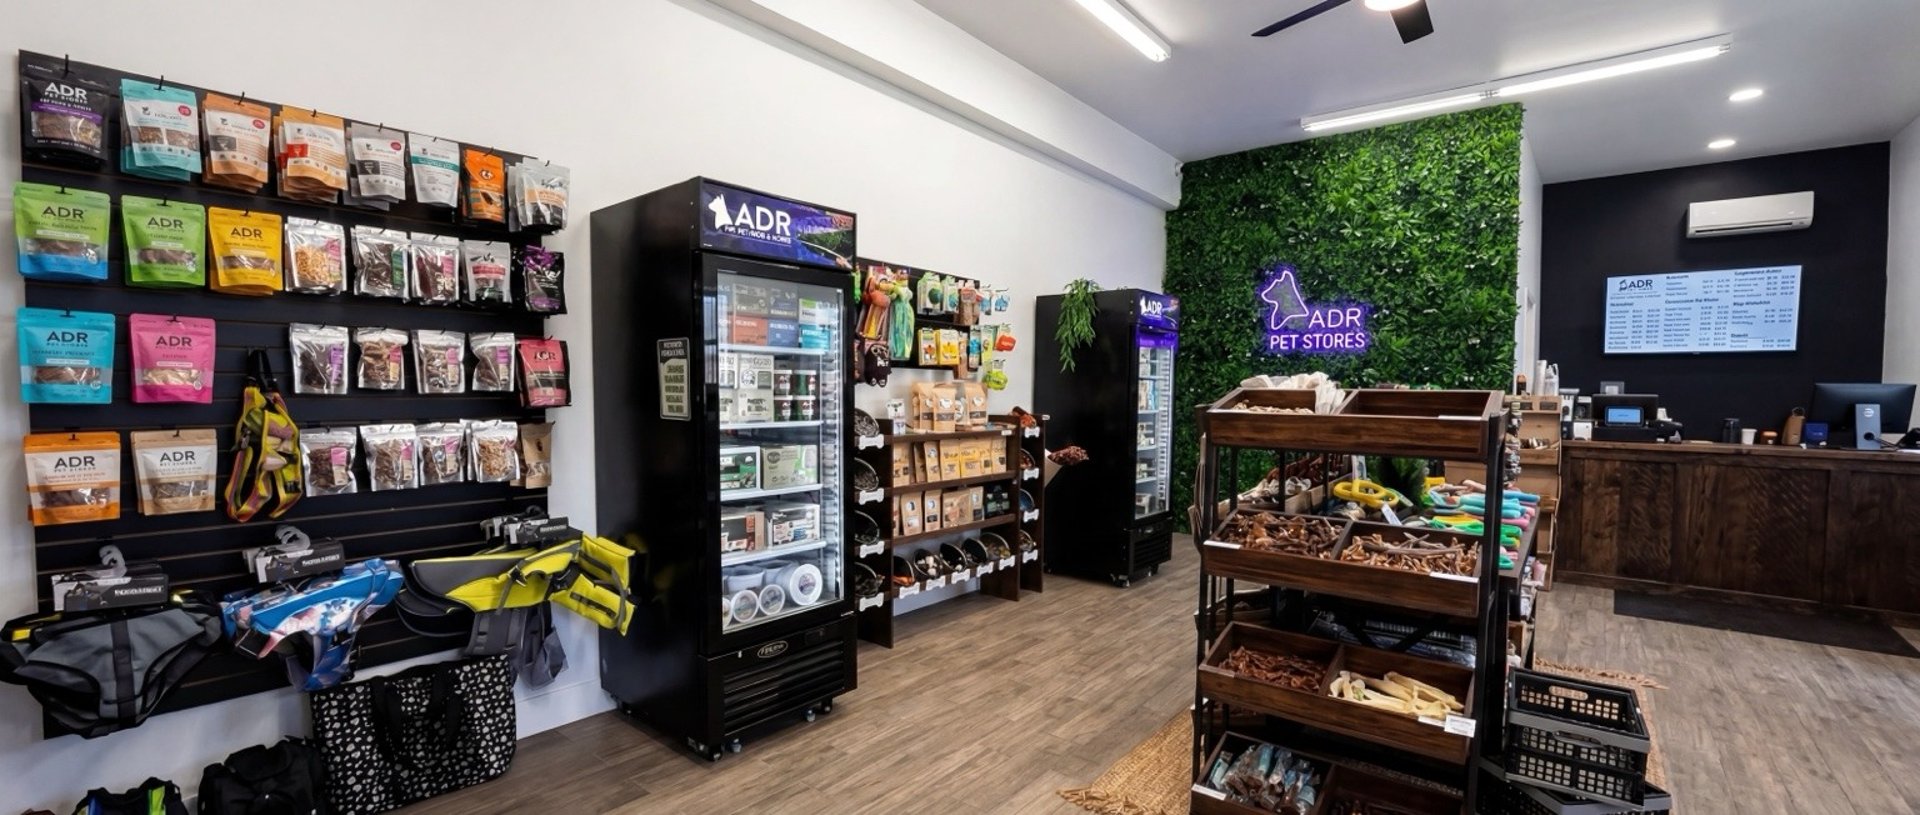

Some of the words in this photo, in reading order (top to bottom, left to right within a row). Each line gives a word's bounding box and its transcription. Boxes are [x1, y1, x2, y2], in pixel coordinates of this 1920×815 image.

[45, 82, 88, 101] ADR
[42, 206, 84, 219] ADR
[734, 202, 791, 236] ADR
[147, 216, 184, 229] ADR
[230, 227, 263, 239] ADR
[1628, 279, 1653, 289] ADR
[1147, 300, 1163, 316] ADR
[1308, 308, 1361, 329] ADR
[47, 331, 89, 343] ADR
[156, 335, 192, 347] ADR
[1270, 334, 1299, 350] PET
[1303, 333, 1365, 349] STORES
[54, 456, 95, 469] ADR
[160, 450, 196, 462] ADR
